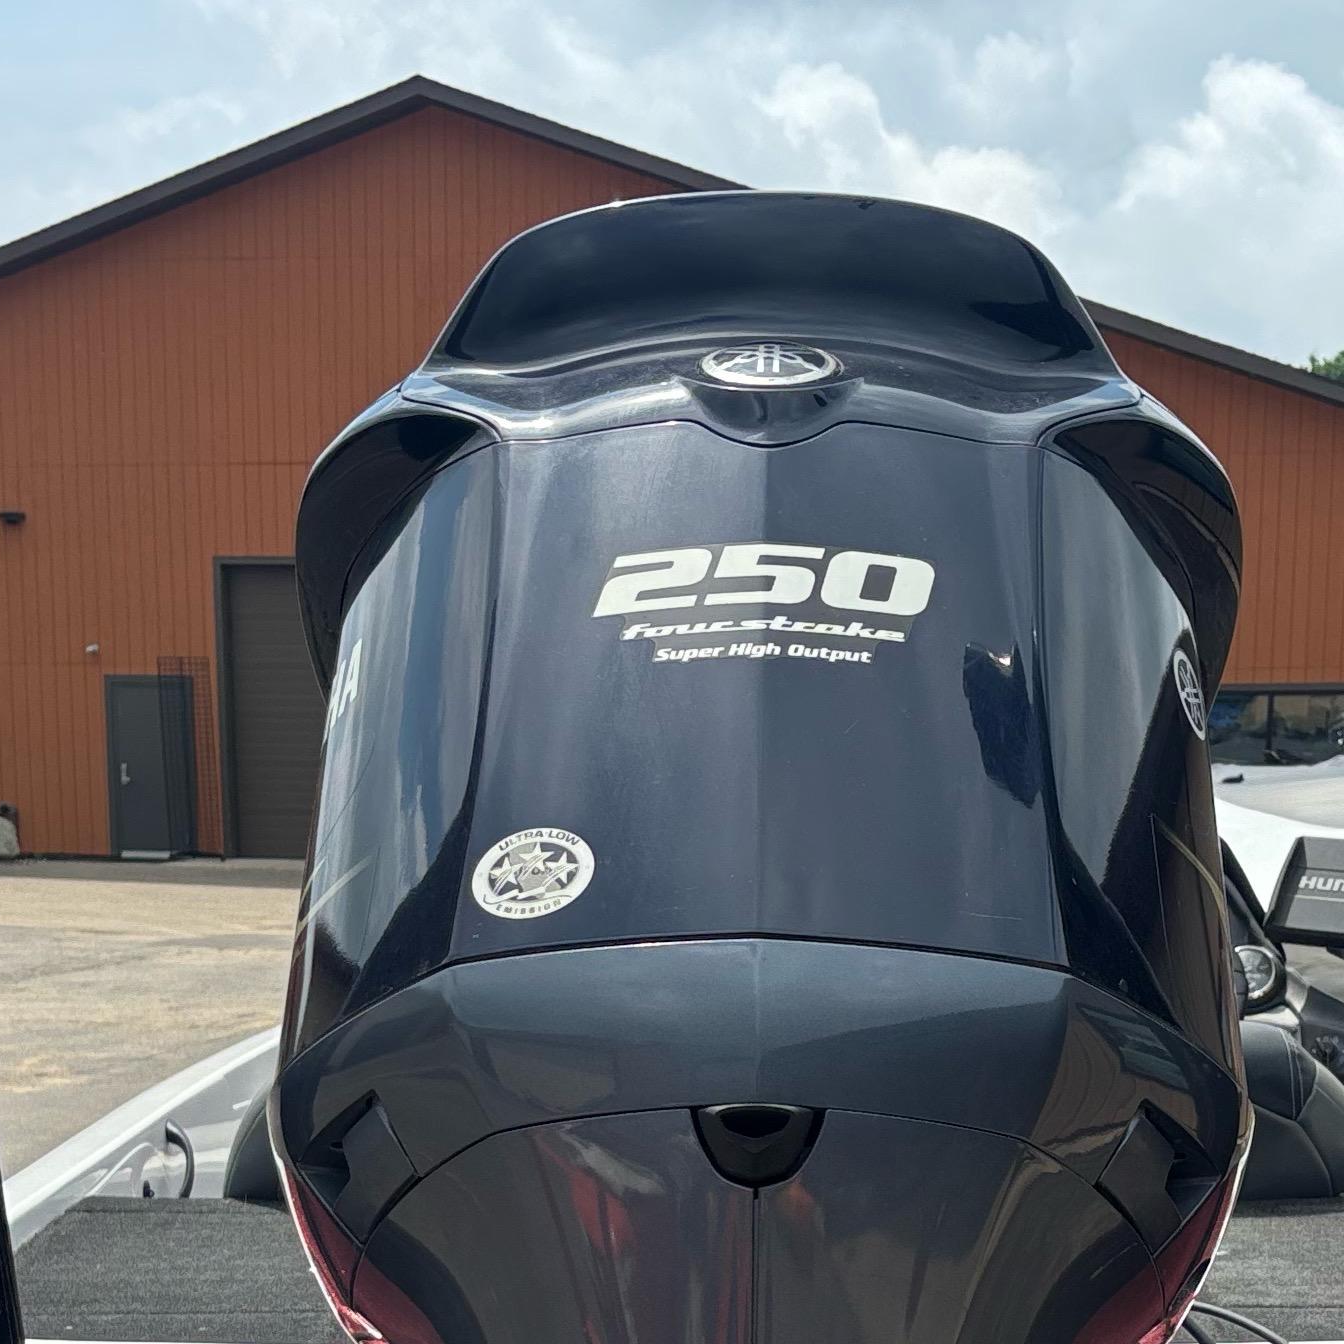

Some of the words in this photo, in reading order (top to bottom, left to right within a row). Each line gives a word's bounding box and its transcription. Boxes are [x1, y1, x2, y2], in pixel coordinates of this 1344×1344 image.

[592, 543, 936, 617] 250
[654, 645, 725, 663] Super
[728, 643, 781, 660] High
[787, 645, 873, 664] Output
[498, 830, 544, 851] ULTRA
